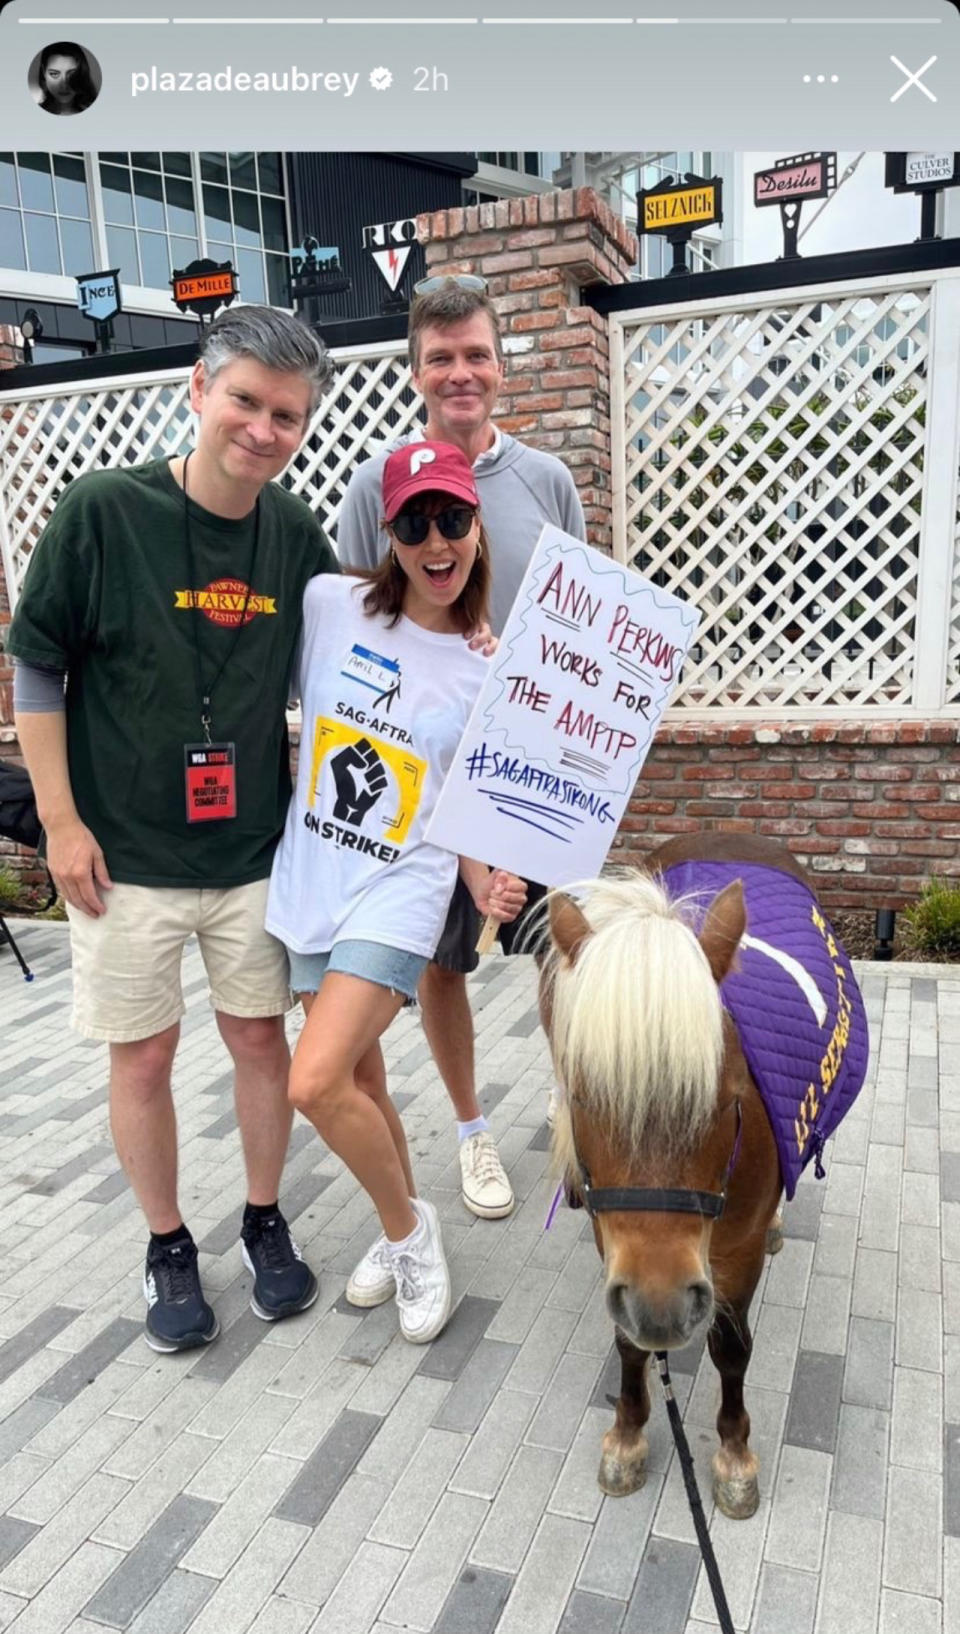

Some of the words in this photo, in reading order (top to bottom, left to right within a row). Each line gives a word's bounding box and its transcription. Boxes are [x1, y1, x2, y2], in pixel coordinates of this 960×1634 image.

[908, 167, 952, 180] STUDIOS
[910, 158, 949, 170] CULVER
[759, 168, 817, 193] Desilu
[646, 193, 712, 222] SELZNICK
[364, 220, 416, 248] RKO
[410, 448, 436, 476] P
[537, 562, 602, 627] ANN
[607, 605, 684, 682] PERKINS
[507, 676, 552, 714] THE
[553, 701, 637, 760] AMPTP
[304, 811, 320, 834] ON
[321, 821, 401, 864] STRIKE!
